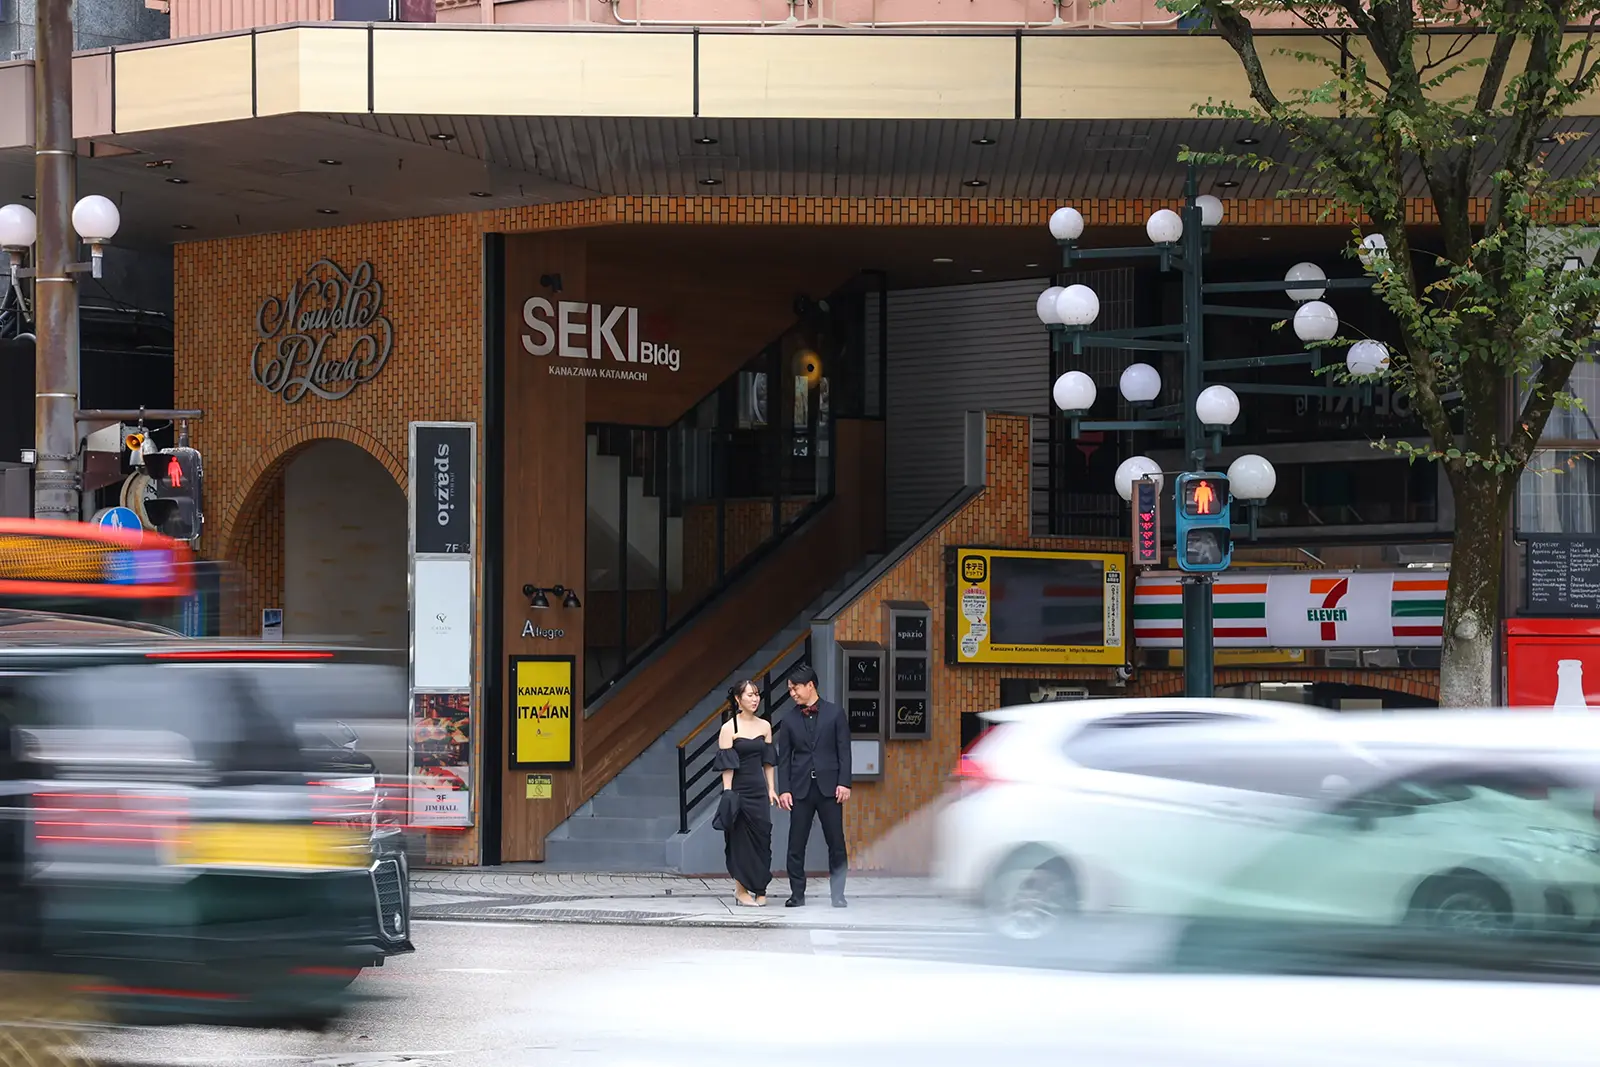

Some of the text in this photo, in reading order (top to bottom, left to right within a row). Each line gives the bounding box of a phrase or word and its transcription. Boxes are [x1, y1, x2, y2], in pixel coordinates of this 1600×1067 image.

[256, 259, 382, 339] Nouvelle
[521, 297, 680, 371] SEKI Bldg
[251, 316, 392, 404] Plaza
[548, 366, 648, 382] KANAZAWA KATAMACHI
[434, 444, 454, 526] spazio
[445, 543, 459, 552] 7F
[966, 563, 983, 571] キテミ
[1309, 577, 1348, 641] 7
[521, 619, 565, 640] Allegro
[898, 630, 923, 639] spazio
[872, 660, 877, 668] 4
[518, 686, 571, 696] KANAZAWA
[518, 705, 569, 720] ITALIAN
